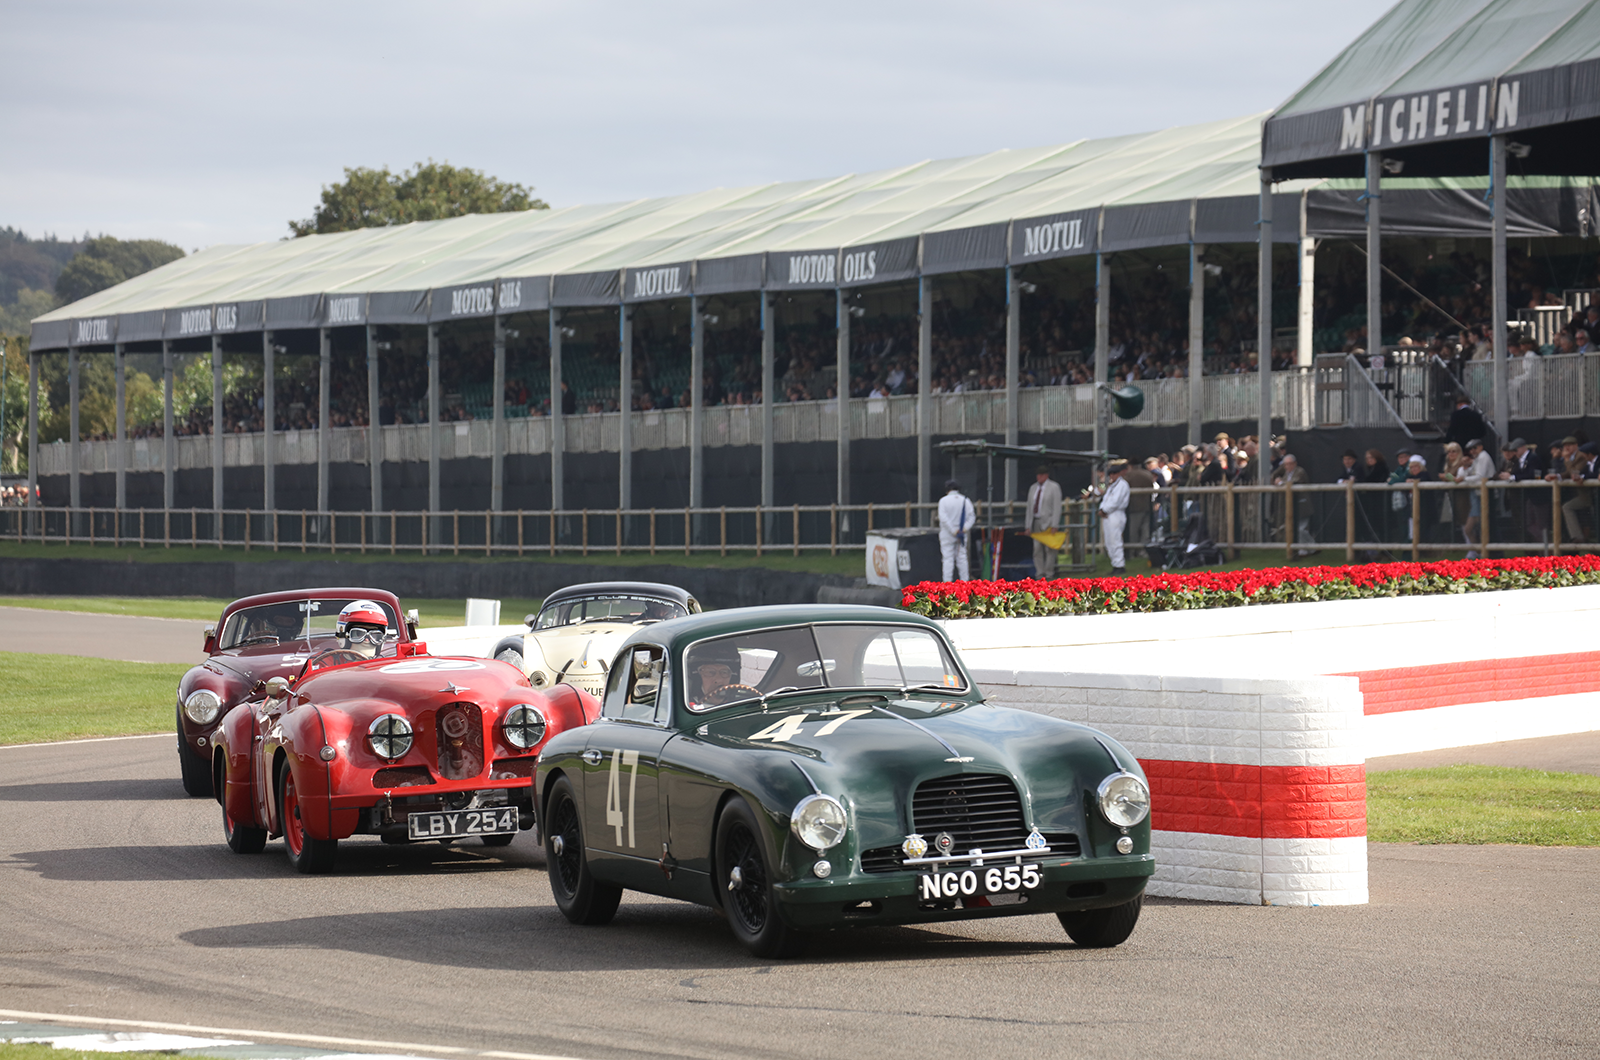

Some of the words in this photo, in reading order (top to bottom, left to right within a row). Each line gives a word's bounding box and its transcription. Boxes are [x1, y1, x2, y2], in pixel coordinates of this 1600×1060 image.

[1340, 81, 1520, 150] MICHELIN
[1023, 219, 1084, 256] MOTUL
[633, 267, 682, 298] MOTUL
[788, 254, 835, 284] MOTOR
[843, 250, 876, 283] OILS
[329, 297, 360, 323] MOTUL
[451, 287, 494, 315] MOTOR
[499, 281, 522, 308] OILS
[77, 318, 109, 343] MOTUL
[180, 309, 212, 334] MOTOR
[216, 306, 237, 330] OILS
[748, 709, 873, 742] 47
[606, 749, 639, 848] 47
[413, 813, 459, 836] LBY
[466, 810, 513, 833] 254
[922, 870, 978, 899] NGO
[985, 864, 1040, 892] 655
